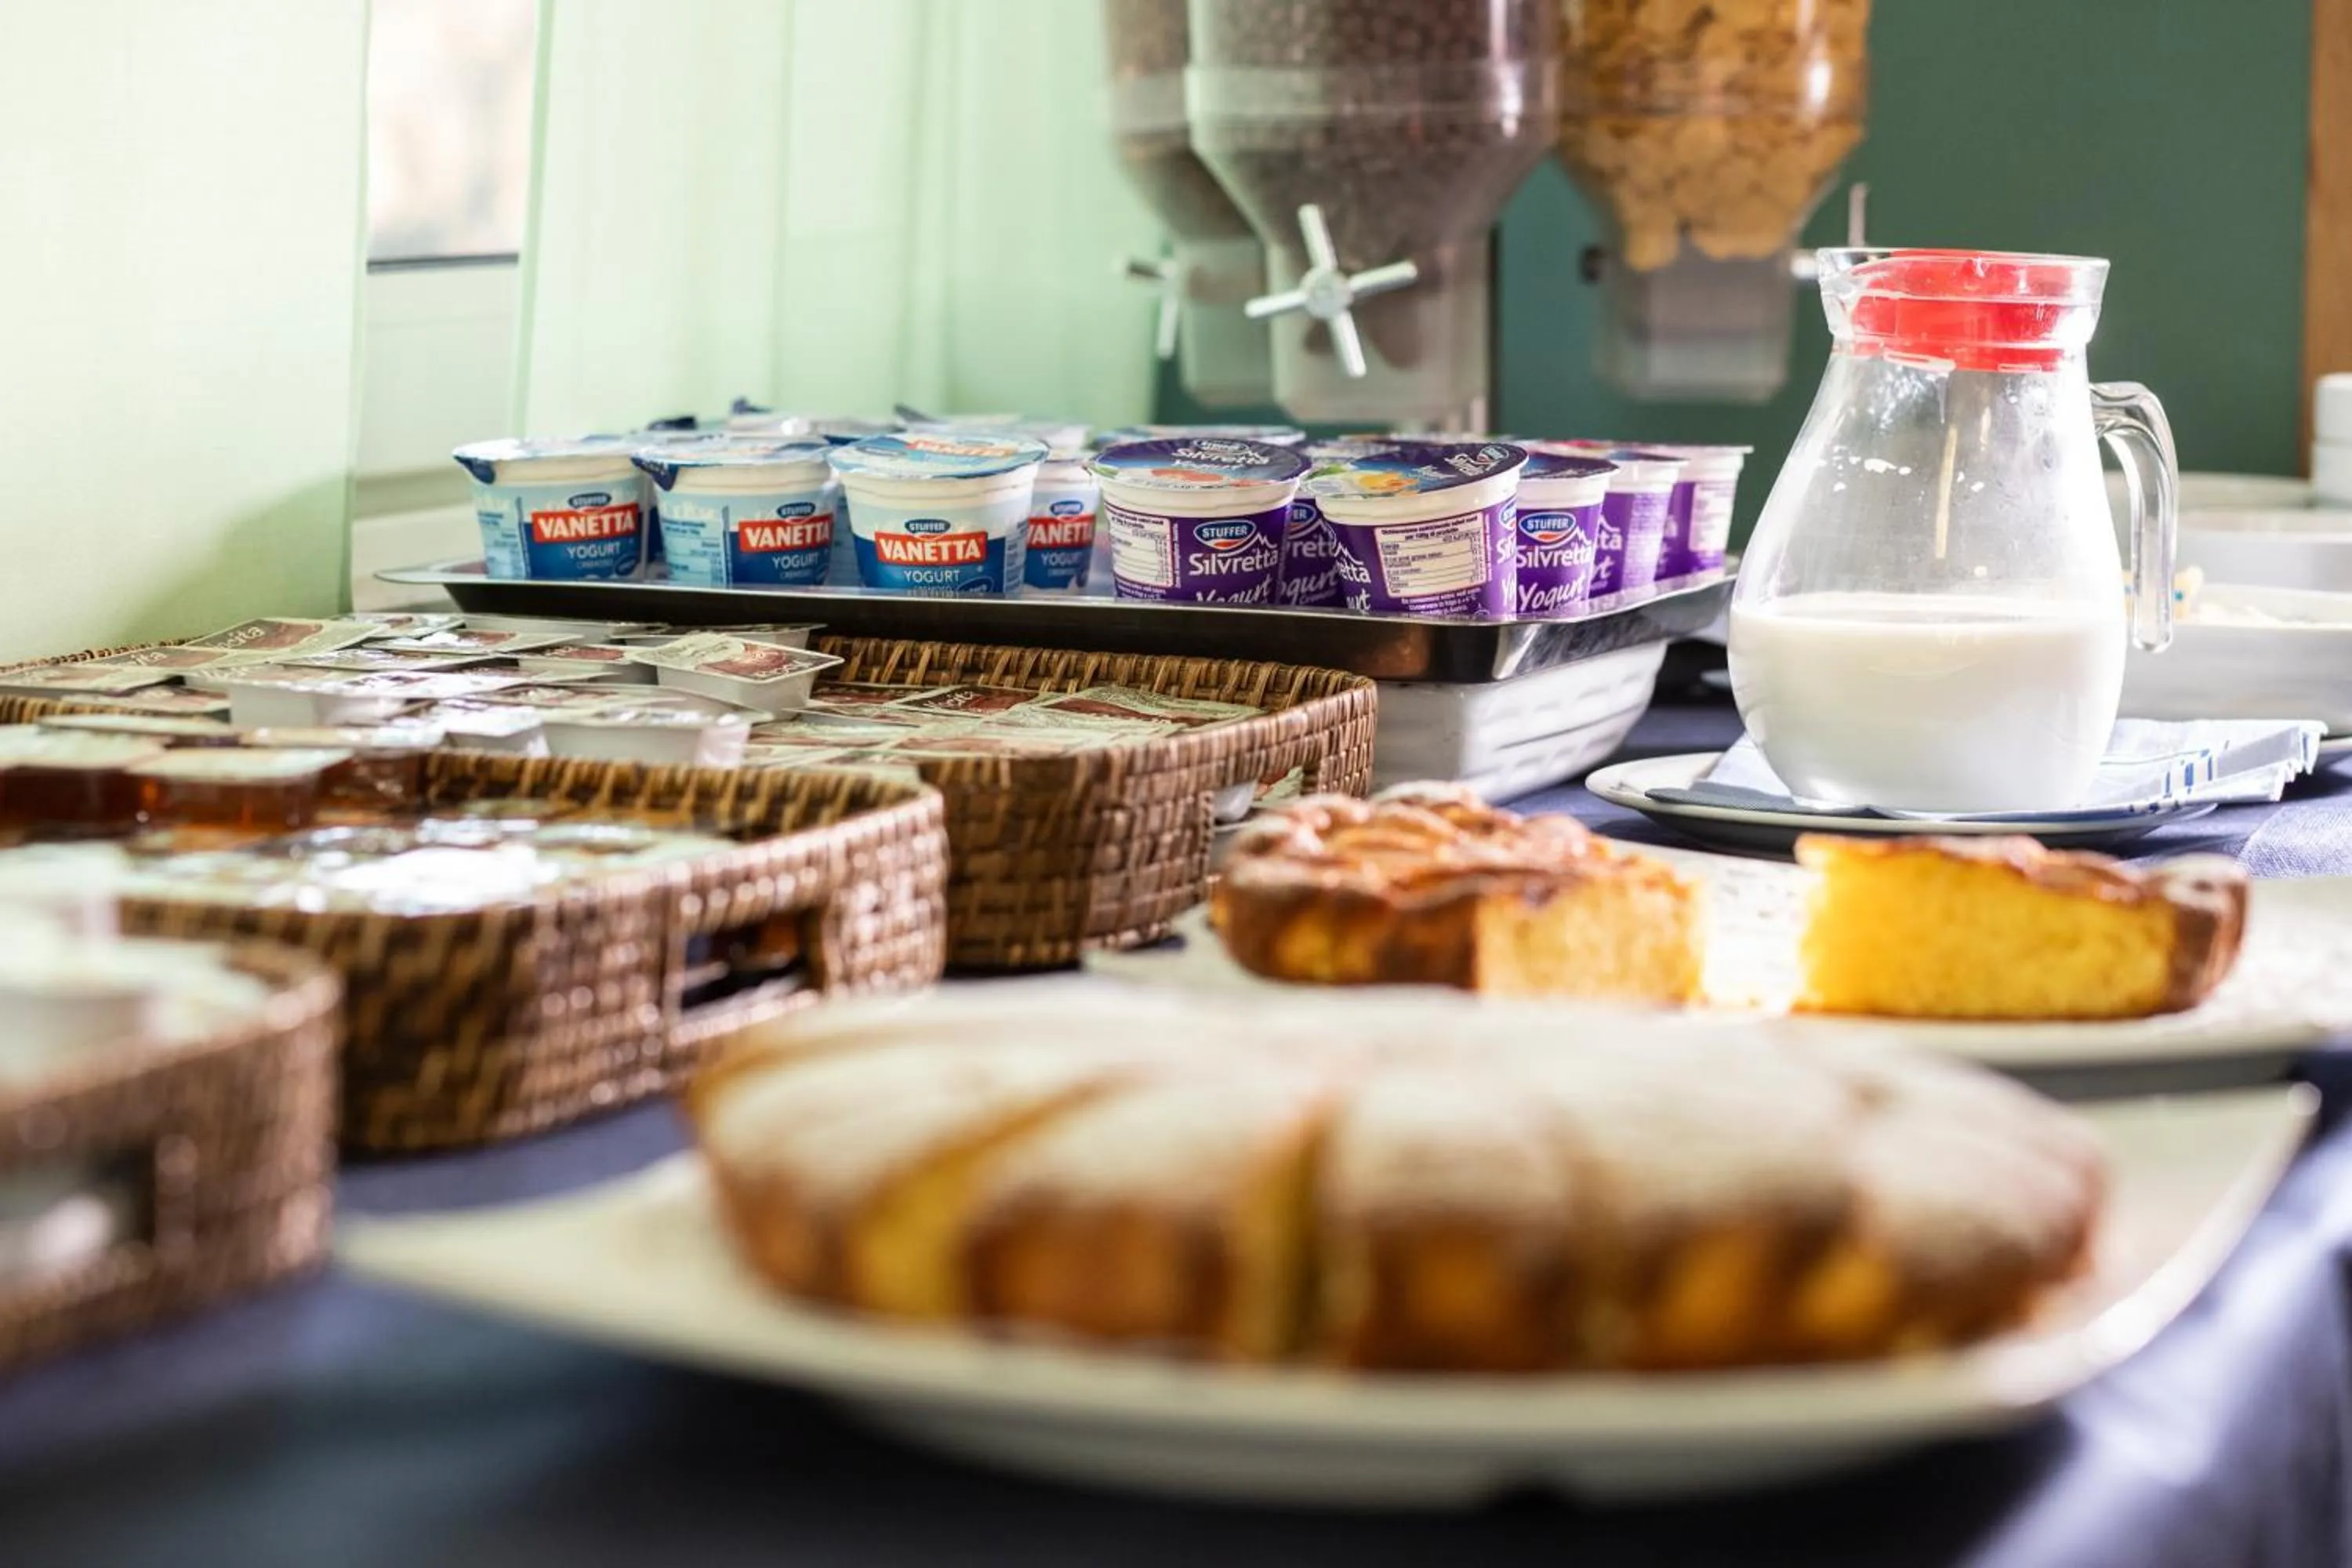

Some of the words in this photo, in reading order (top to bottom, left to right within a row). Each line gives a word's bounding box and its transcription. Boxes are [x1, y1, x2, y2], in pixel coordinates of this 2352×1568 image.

[535, 510, 635, 539] VANETTA
[909, 522, 946, 532] STUFFER
[1202, 525, 1248, 538] STUFFER
[1526, 517, 1569, 531] STUFFER
[744, 521, 830, 549] VANETTA
[566, 541, 621, 559] YOGURT
[878, 539, 981, 562] VANETTA
[1516, 541, 1594, 568] Silvretta
[771, 552, 818, 569] YOGURT
[1188, 547, 1279, 576] Silvretta
[903, 570, 960, 583] YOGURT
[1519, 573, 1588, 612] Yogurt
